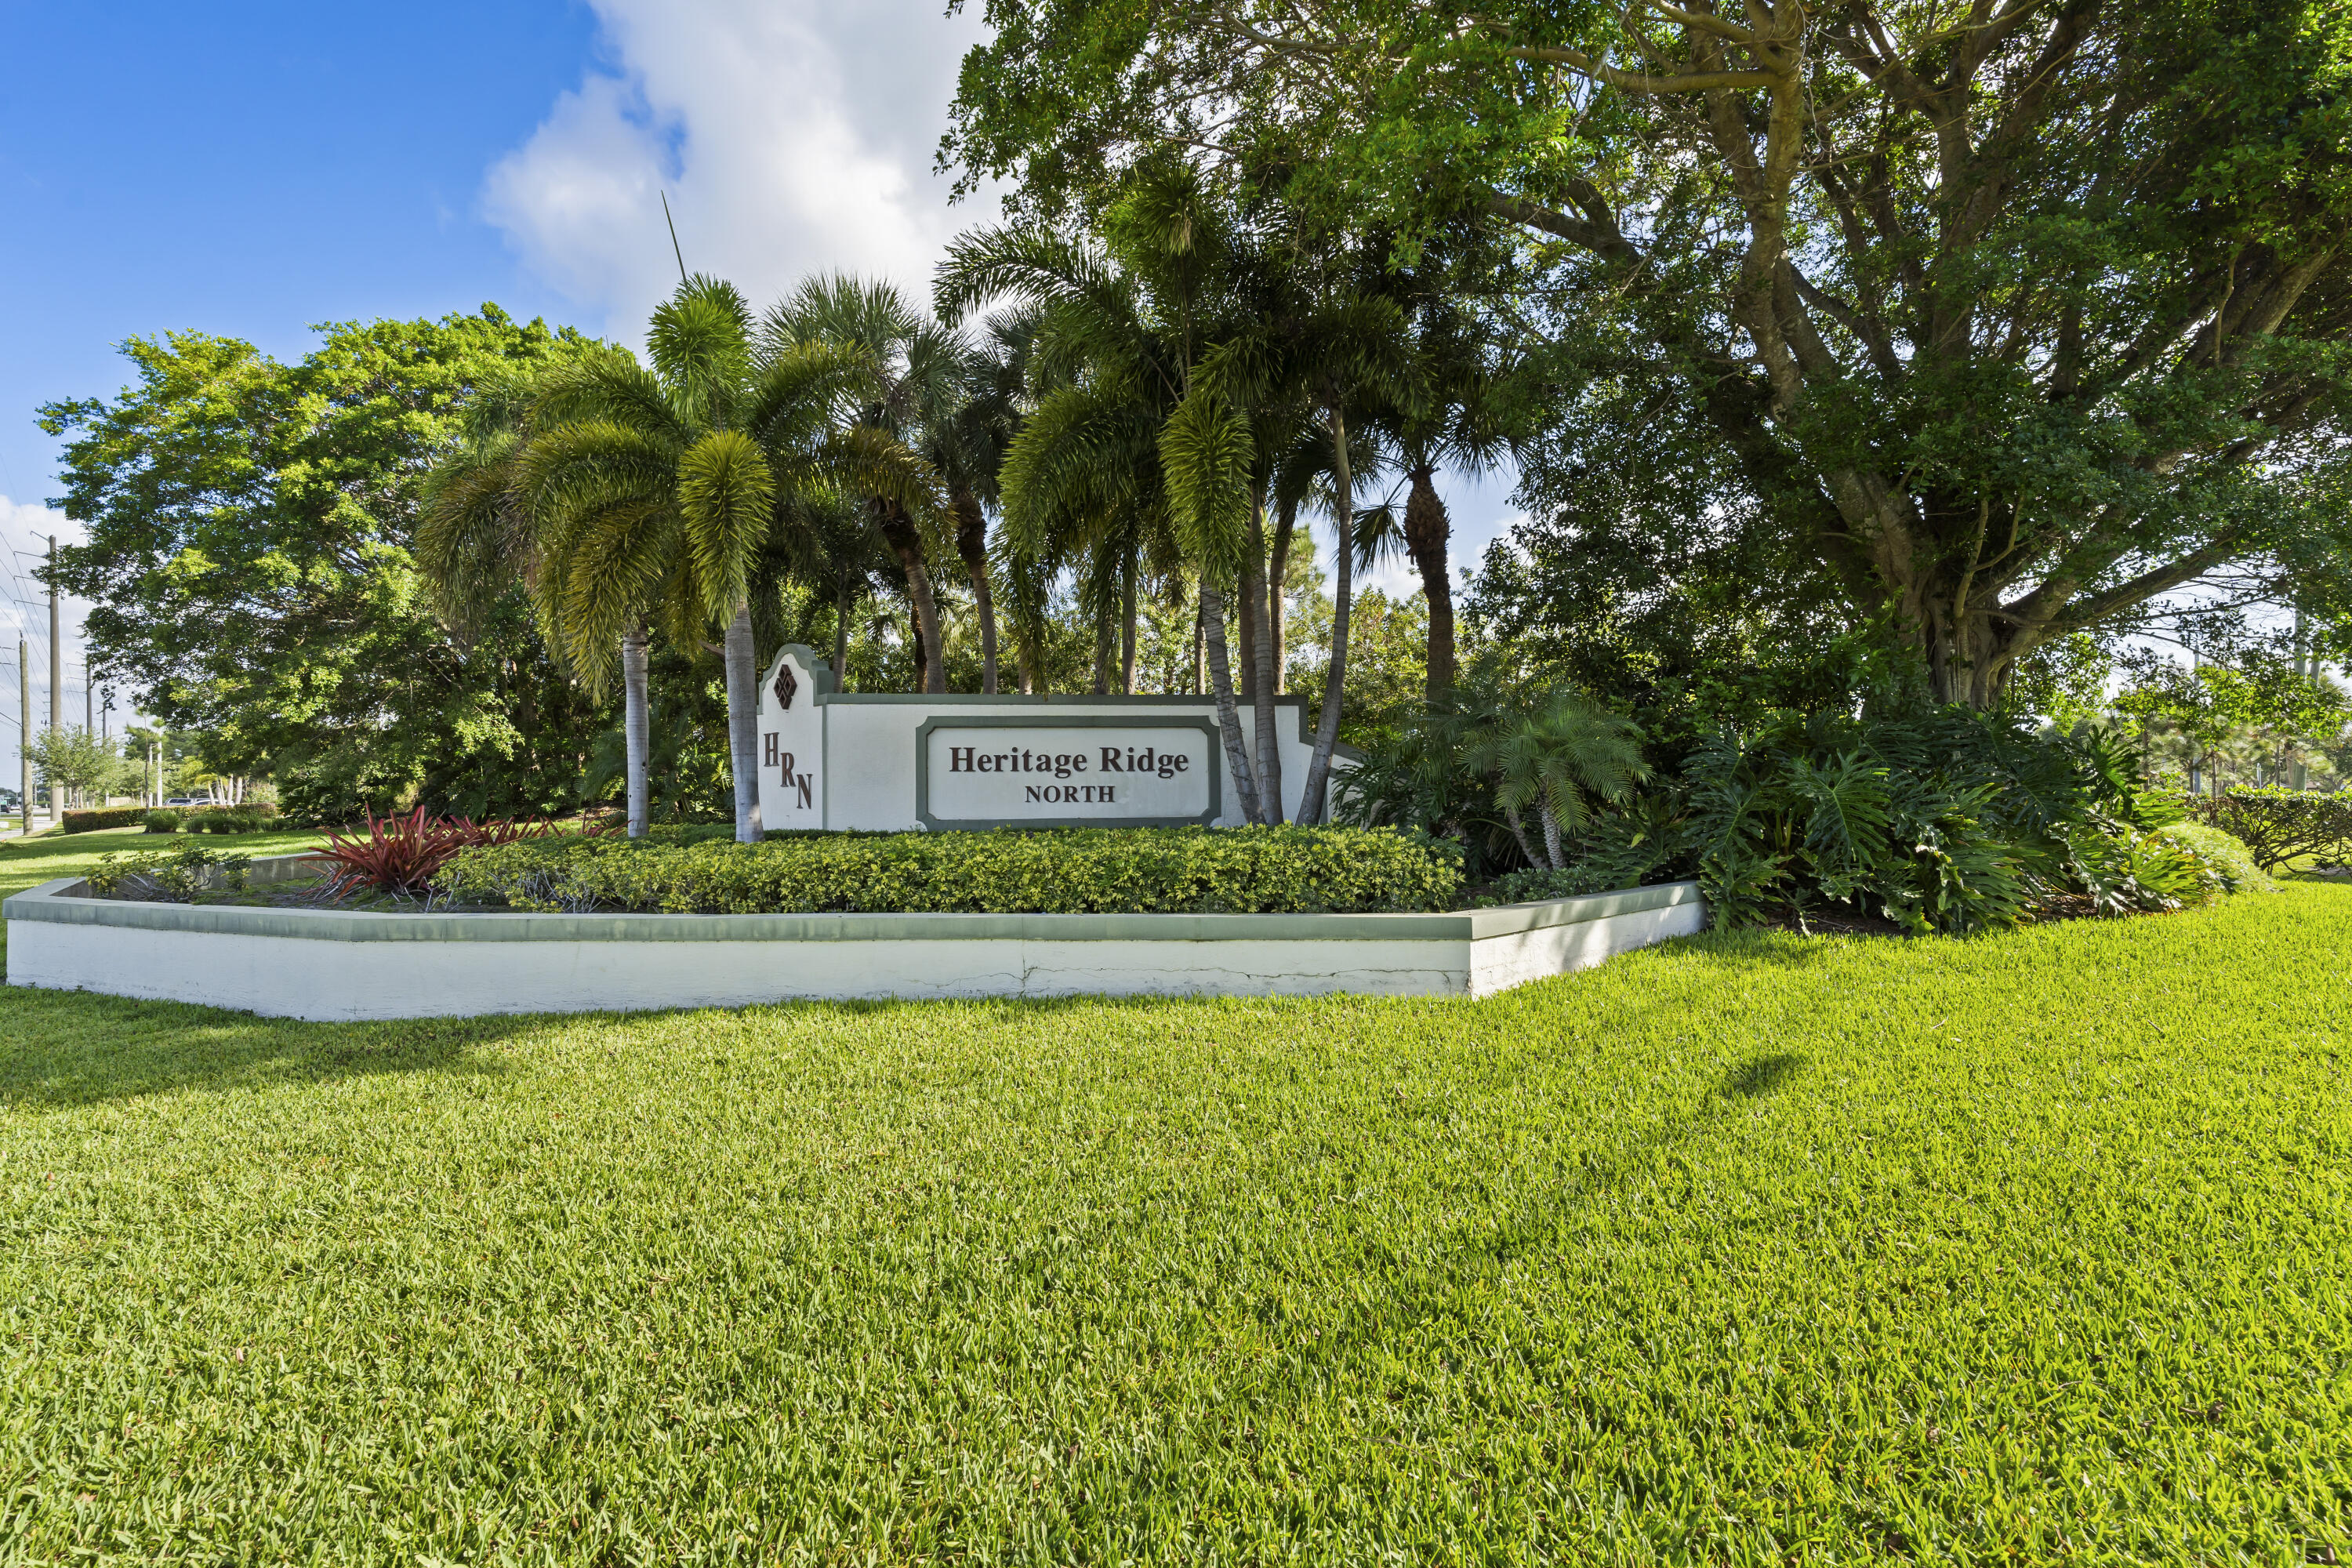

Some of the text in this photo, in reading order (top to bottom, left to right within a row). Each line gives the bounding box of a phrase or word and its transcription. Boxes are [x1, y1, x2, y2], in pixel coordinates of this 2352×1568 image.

[949, 746, 1189, 780] Heritage Ridge
[1024, 785, 1116, 804] NORTH
